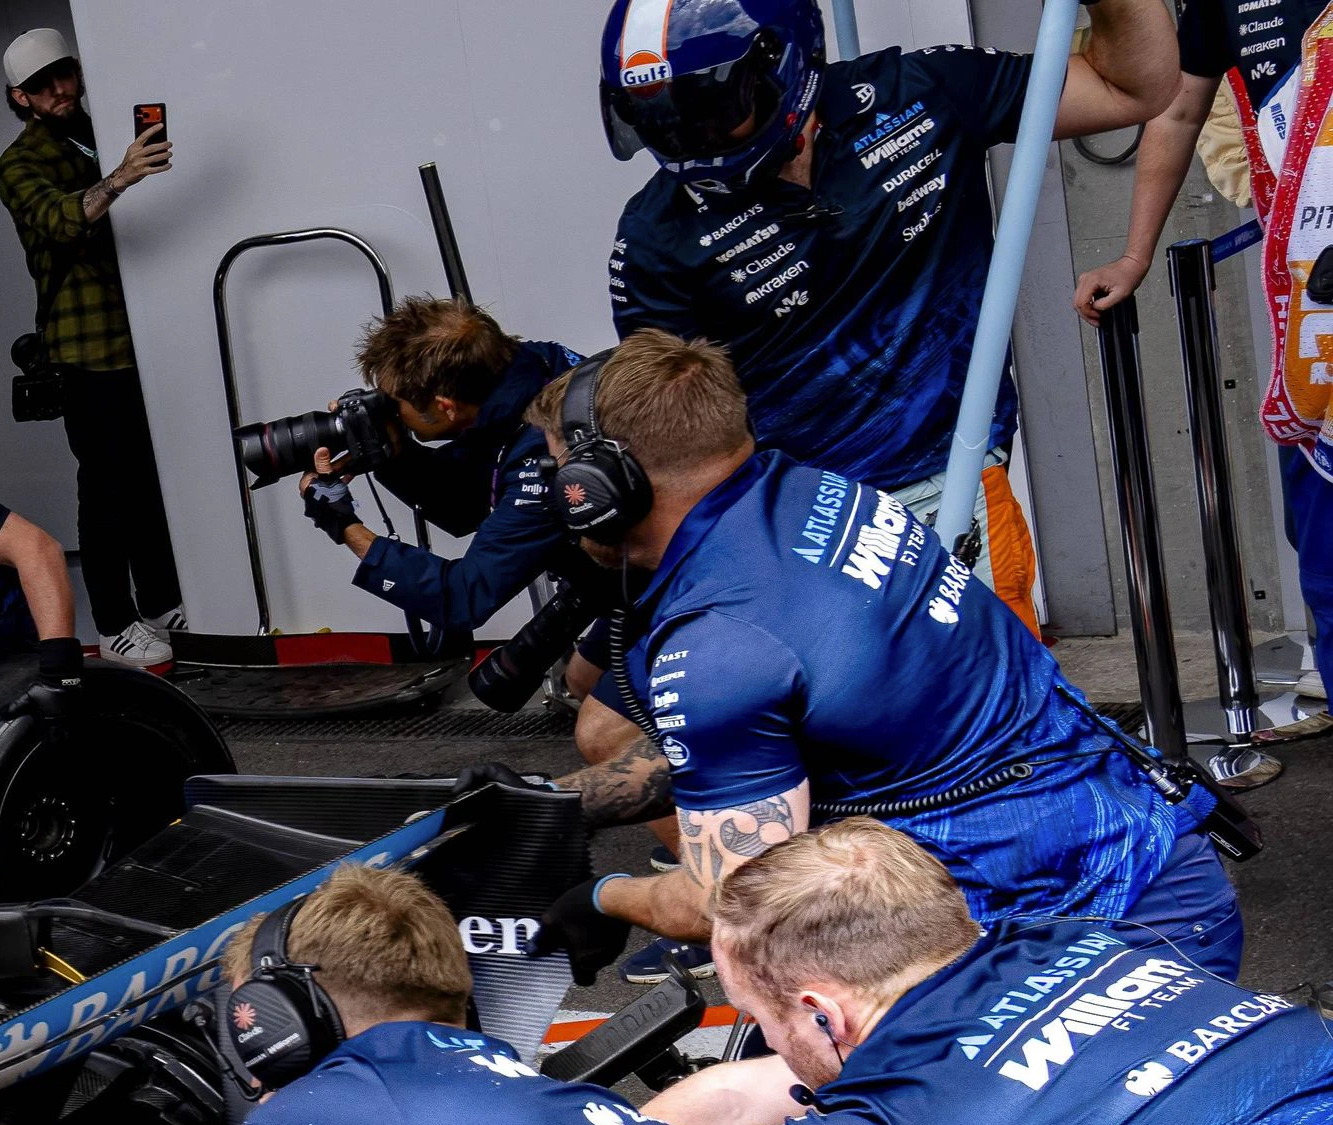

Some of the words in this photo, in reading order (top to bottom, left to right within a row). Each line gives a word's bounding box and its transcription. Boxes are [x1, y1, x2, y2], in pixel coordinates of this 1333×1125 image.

[1248, 17, 1283, 33] Claude
[623, 62, 670, 87] Gulf
[853, 101, 925, 153] ATLASSIAN
[860, 117, 935, 170] Williams
[899, 140, 921, 157] TEAM
[882, 148, 943, 193] DURACELL
[897, 173, 947, 214] betway
[712, 203, 764, 241] BARCLAYS
[715, 223, 780, 263] KOMATSU
[745, 242, 796, 276] Claude
[758, 260, 809, 297] kraken
[569, 503, 593, 514] Claude
[900, 550, 919, 567] F1
[1111, 1014, 1145, 1032] F1
[1140, 976, 1204, 1009] TEAM
[238, 1026, 263, 1044] Claude
[267, 1033, 299, 1054] Williams
